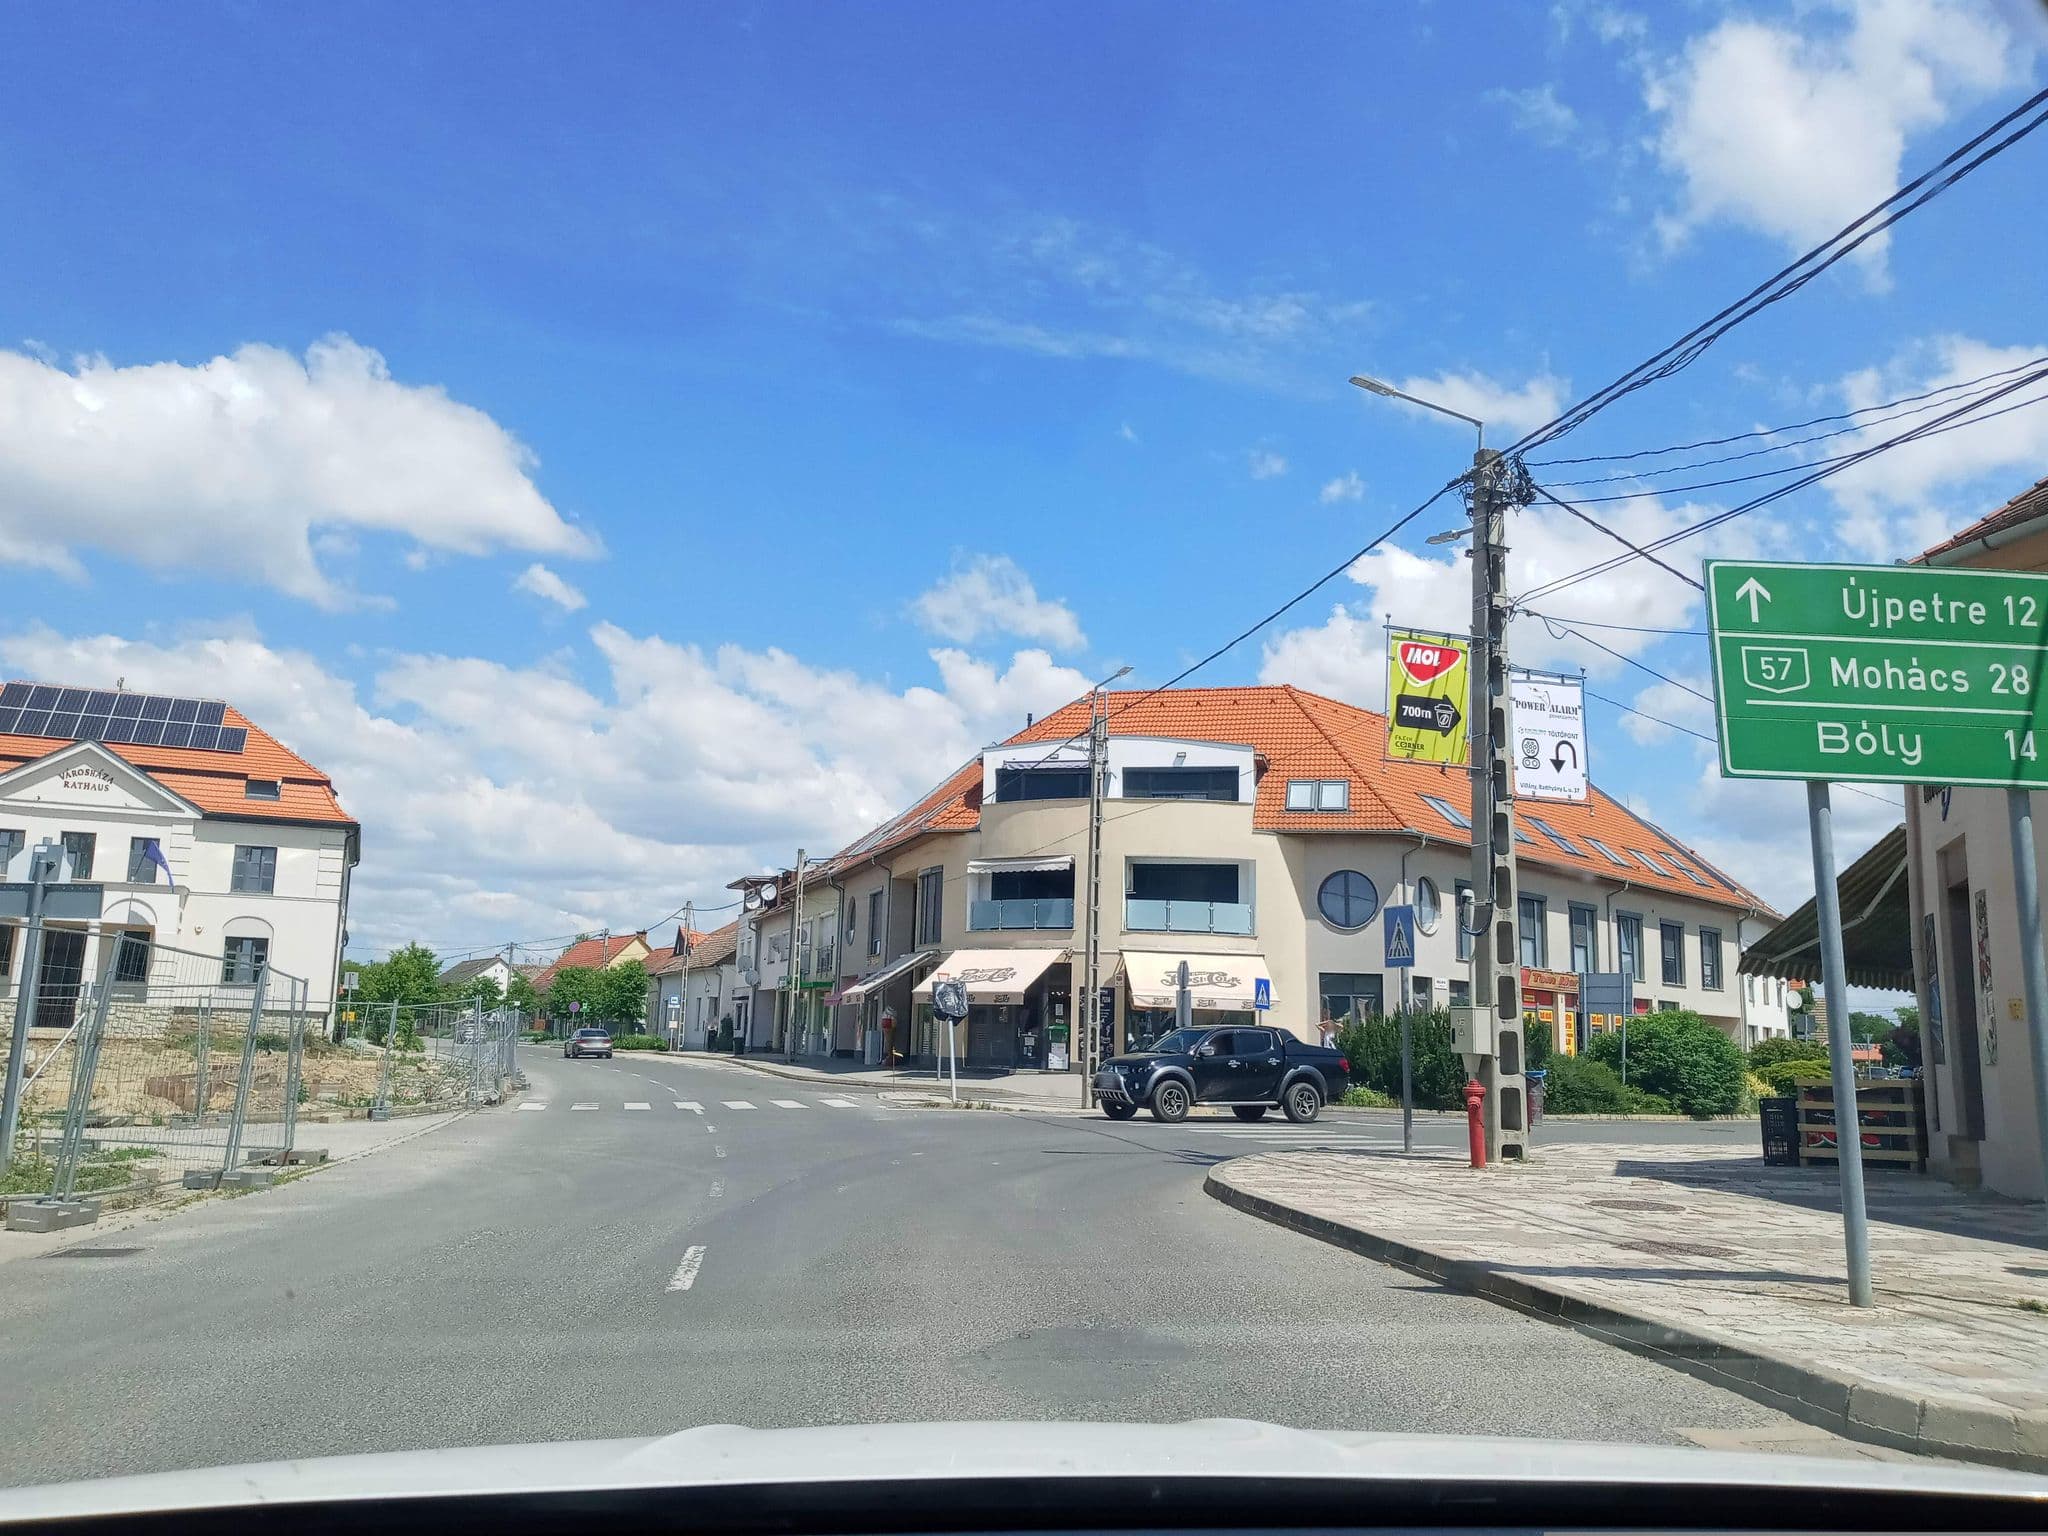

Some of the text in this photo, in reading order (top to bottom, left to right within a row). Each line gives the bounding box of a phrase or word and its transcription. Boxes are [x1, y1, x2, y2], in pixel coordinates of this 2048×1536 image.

[1842, 577, 2038, 629] Újpetre 12
[1405, 647, 1440, 667] MOL
[1760, 657, 1792, 681] 57
[1830, 657, 2031, 696] Mohács 28
[1401, 705, 1432, 719] 700m
[1515, 700, 1578, 716] POWER ALARM
[1394, 741, 1425, 751] CORNER
[1817, 721, 2038, 766] Bóly 14
[59, 768, 114, 784] VÁROSHÁZA
[63, 780, 110, 791] RATHAUS
